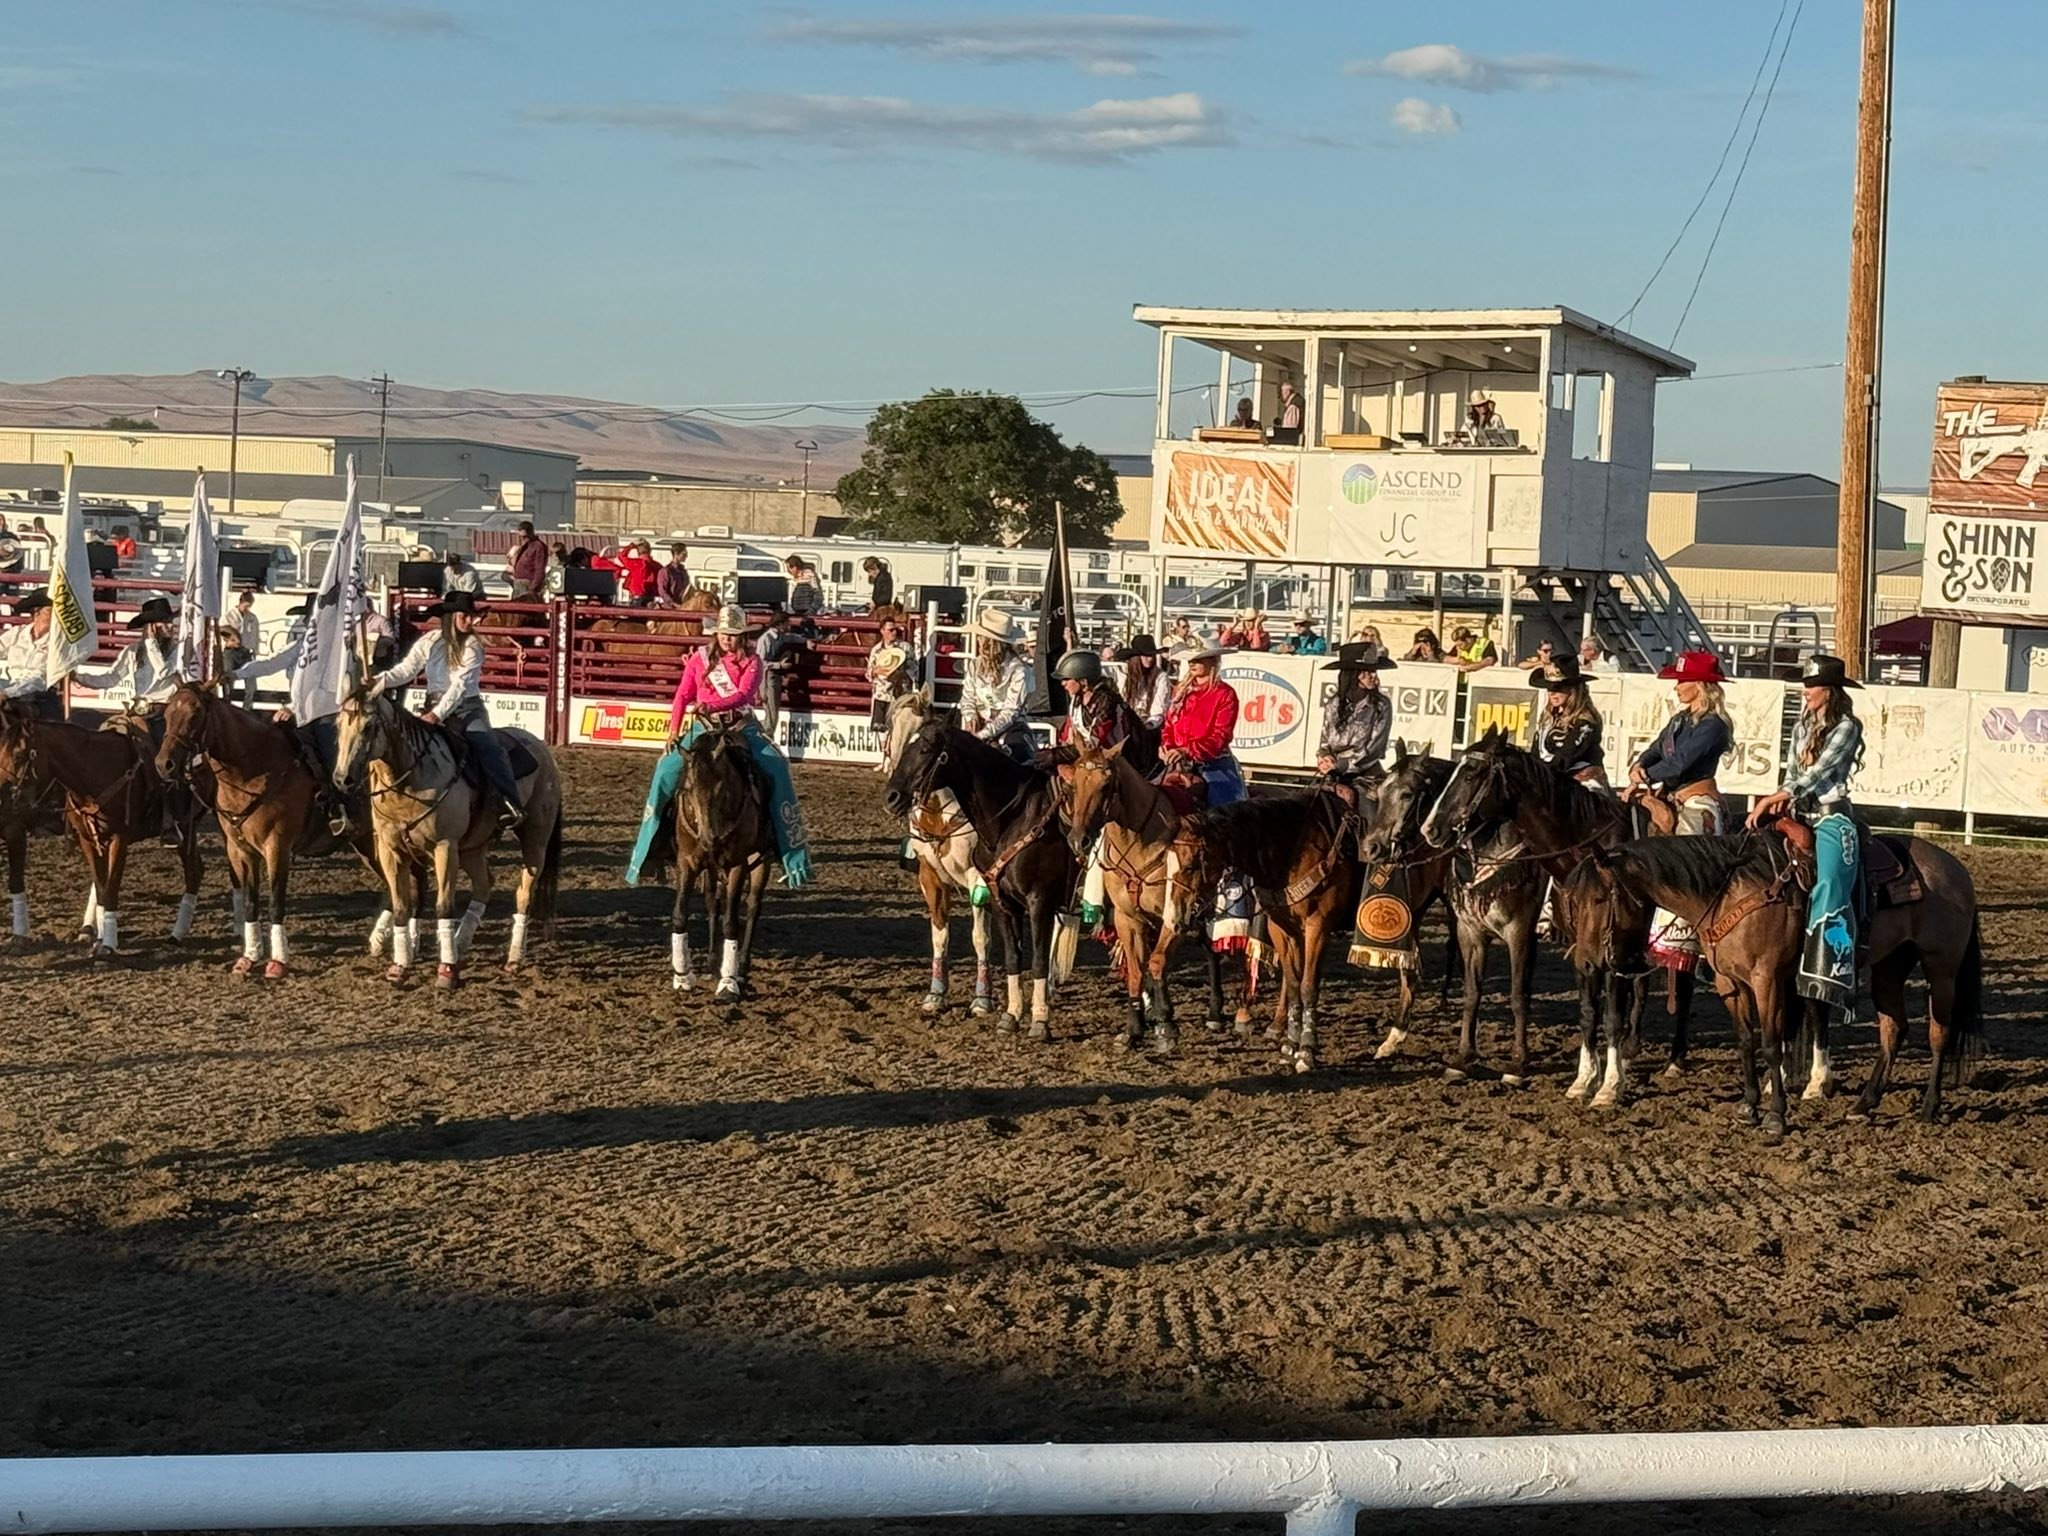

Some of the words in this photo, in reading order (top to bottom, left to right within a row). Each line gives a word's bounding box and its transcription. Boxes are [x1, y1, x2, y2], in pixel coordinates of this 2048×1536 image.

[1942, 402, 2025, 437] THE
[1379, 471, 1462, 489] ASCEND
[1188, 469, 1273, 515] IDEAL
[1380, 512, 1417, 543] JC
[1938, 520, 2037, 568] SHINN
[551, 572, 562, 589] 3
[724, 580, 736, 598] 2
[1942, 559, 1973, 602] &
[907, 589, 918, 608] 1
[1966, 595, 2031, 607] INCORPORATED
[54, 584, 86, 636] SCHWAB
[1225, 668, 1266, 680] FAMILY
[496, 701, 517, 710] COLD
[519, 702, 540, 711] BEER
[596, 707, 624, 730] Tires
[626, 716, 646, 732] LES
[647, 718, 690, 734] SCHA
[1999, 743, 2036, 755] AUTO
